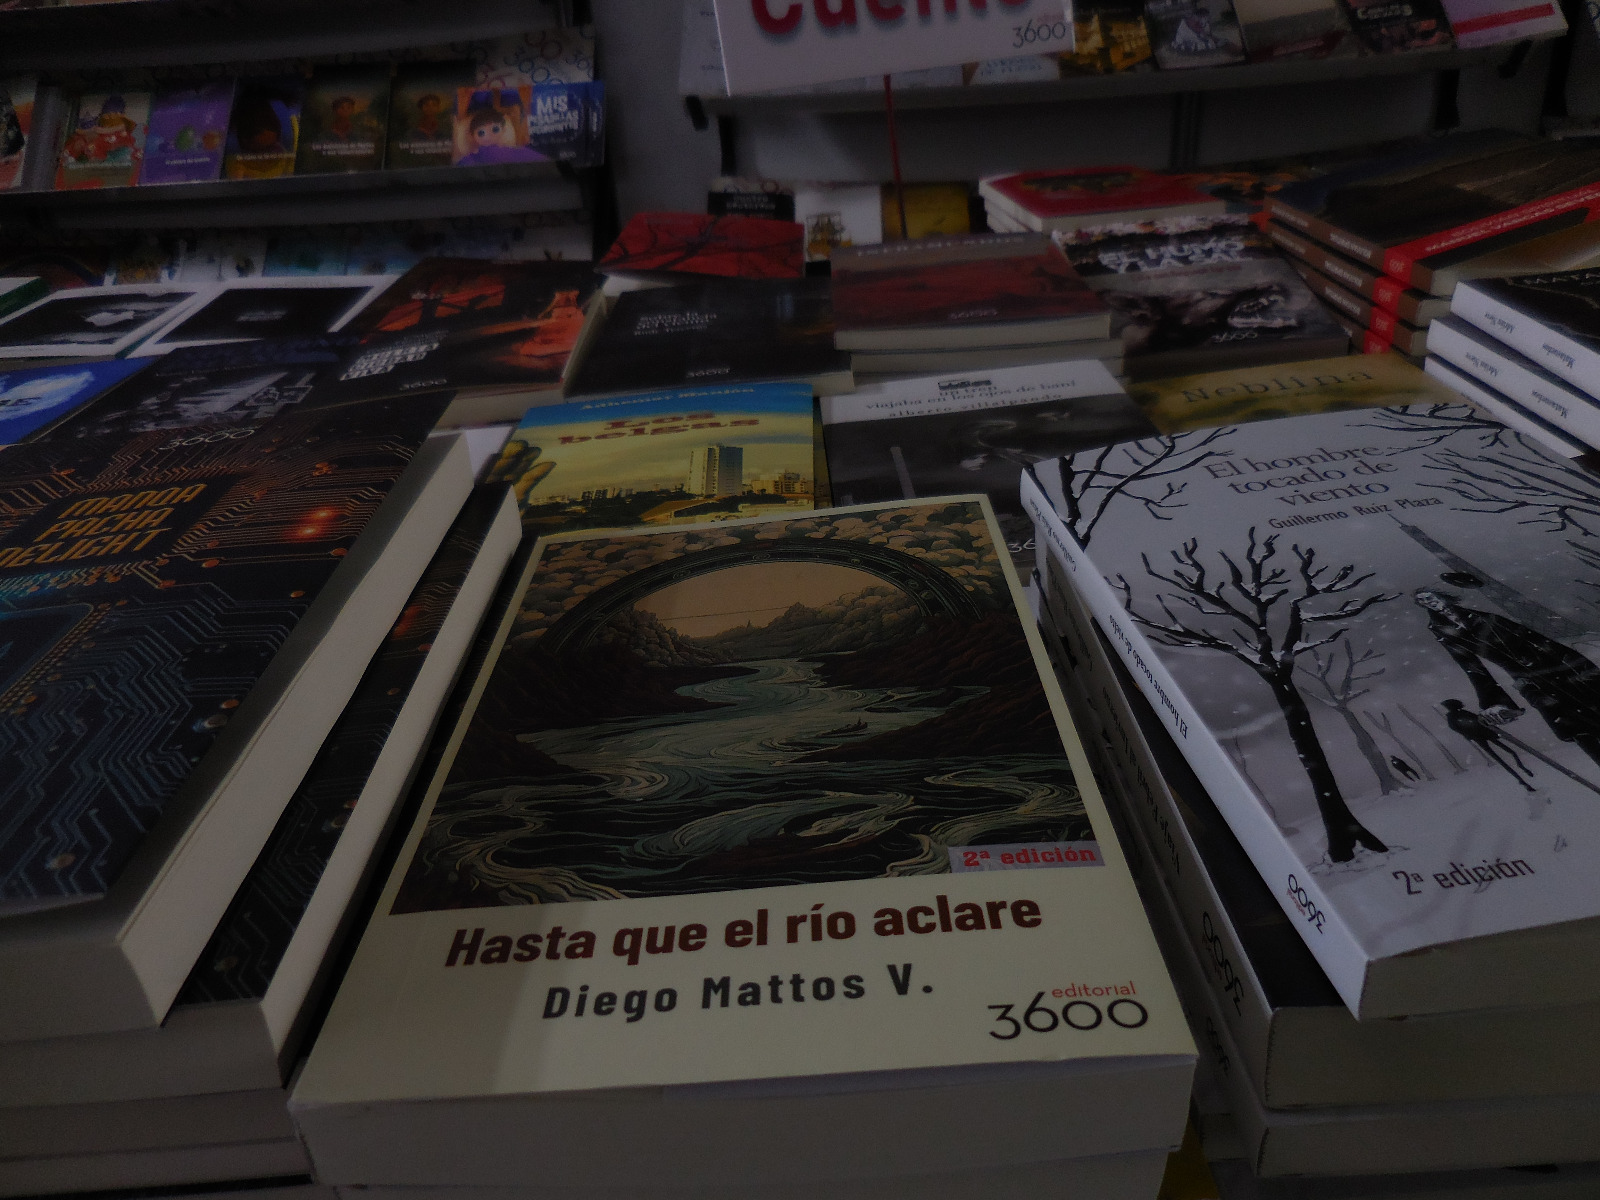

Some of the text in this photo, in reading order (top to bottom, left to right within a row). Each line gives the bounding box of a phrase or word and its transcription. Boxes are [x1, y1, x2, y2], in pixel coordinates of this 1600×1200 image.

[1012, 19, 1066, 48] 3600
[1180, 369, 1374, 403] Neblina
[1204, 446, 1385, 479] El hombre
[1228, 459, 1399, 495] tocado de
[1277, 482, 1390, 507] viento
[33, 507, 175, 543] PACHA
[1268, 496, 1444, 530] Guillermo Ruiz Plaza
[1007, 538, 1036, 553] 36
[1132, 649, 1154, 684] tocado
[1153, 679, 1180, 727] hombre
[1179, 718, 1188, 740] El
[1000, 846, 1098, 865] edición
[1432, 858, 1535, 889] edición
[1288, 874, 1326, 934] 3600
[445, 894, 1043, 967] Hasta que el río aclare
[1203, 911, 1244, 1017] 3600
[542, 963, 934, 1024] Diego Mattos V.
[1051, 981, 1137, 999] editorial
[987, 991, 1149, 1040] 3600
